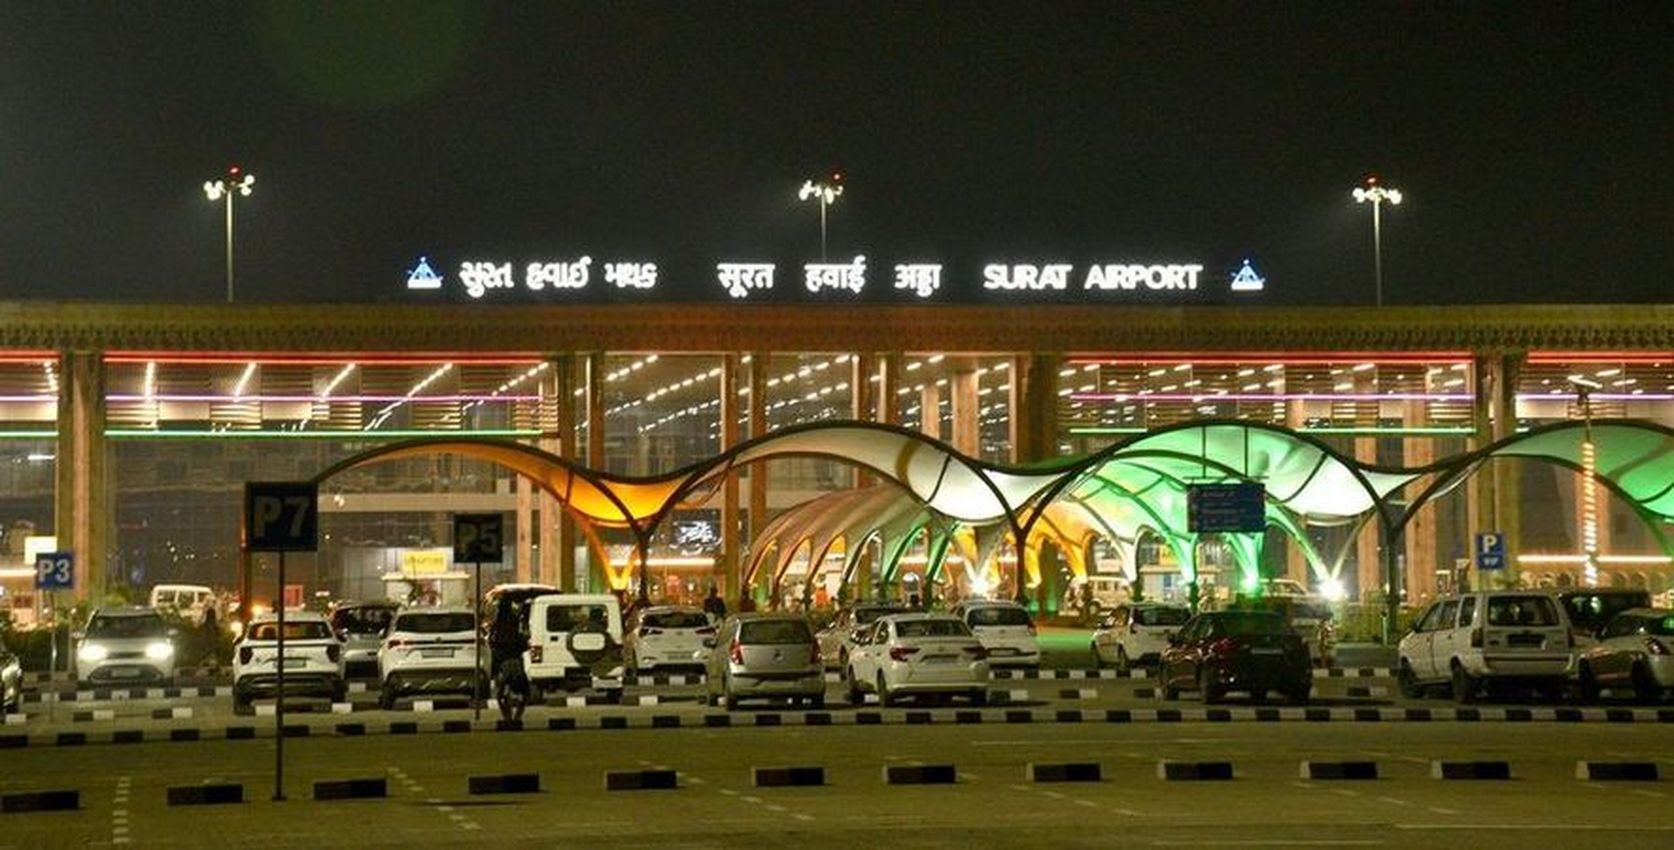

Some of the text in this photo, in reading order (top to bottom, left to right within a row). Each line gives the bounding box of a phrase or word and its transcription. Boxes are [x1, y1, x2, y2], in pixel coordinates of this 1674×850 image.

[459, 256, 658, 298] સુરત હવાઈ મથક
[717, 255, 942, 298] सूरत हवाई अड्डा
[983, 263, 1203, 290] SURAT AIRPORT
[254, 496, 311, 538] P7
[459, 523, 497, 553] P5
[1483, 535, 1497, 554] P
[39, 559, 70, 582] P3
